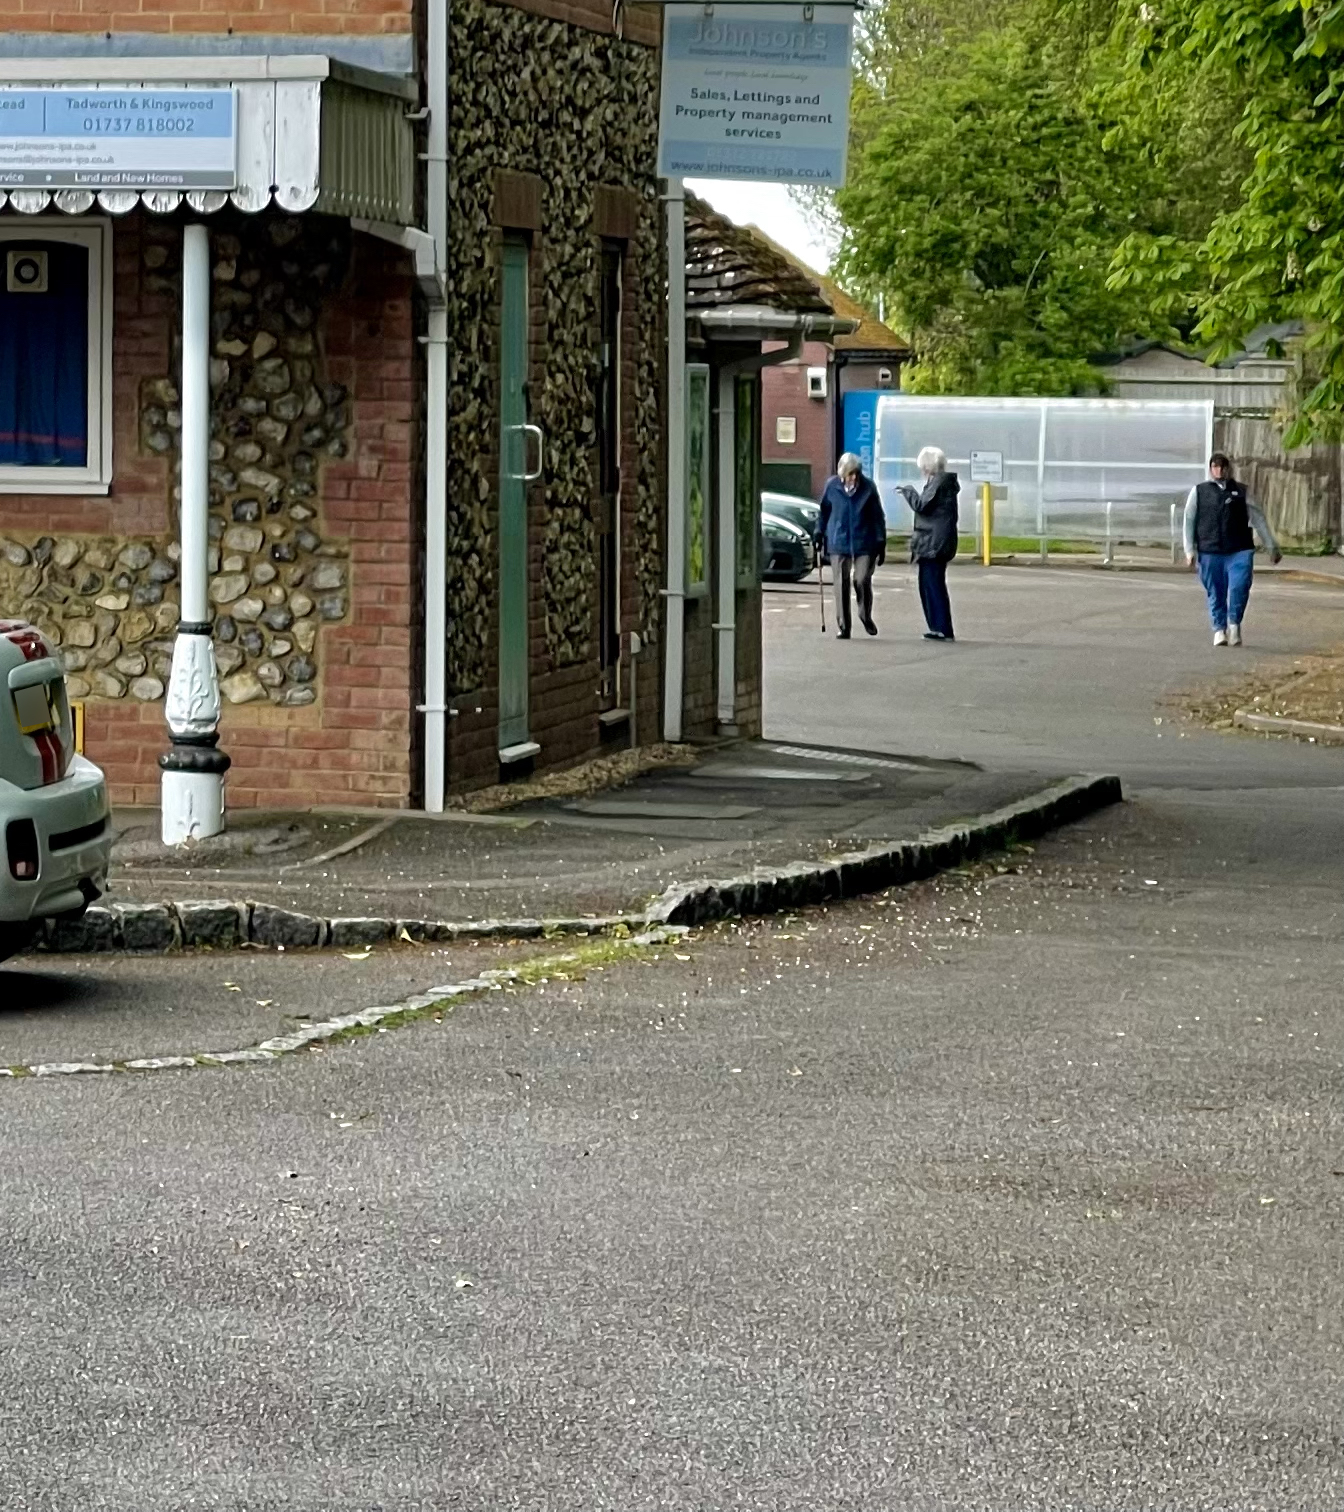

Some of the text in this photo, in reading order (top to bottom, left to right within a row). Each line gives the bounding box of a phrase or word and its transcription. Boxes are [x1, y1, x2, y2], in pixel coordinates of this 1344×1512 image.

[689, 21, 828, 49] Johnson's
[66, 98, 214, 112] Tadworth & Kingswood
[690, 88, 820, 106] Sales, Lettings and
[675, 105, 833, 124] Property management
[83, 118, 195, 132] 01737 818002
[724, 127, 782, 139] services
[74, 173, 184, 184] Land and New Homes
[671, 160, 833, 179] www.johnsons-ipa.co.uk
[856, 411, 871, 441] hub
